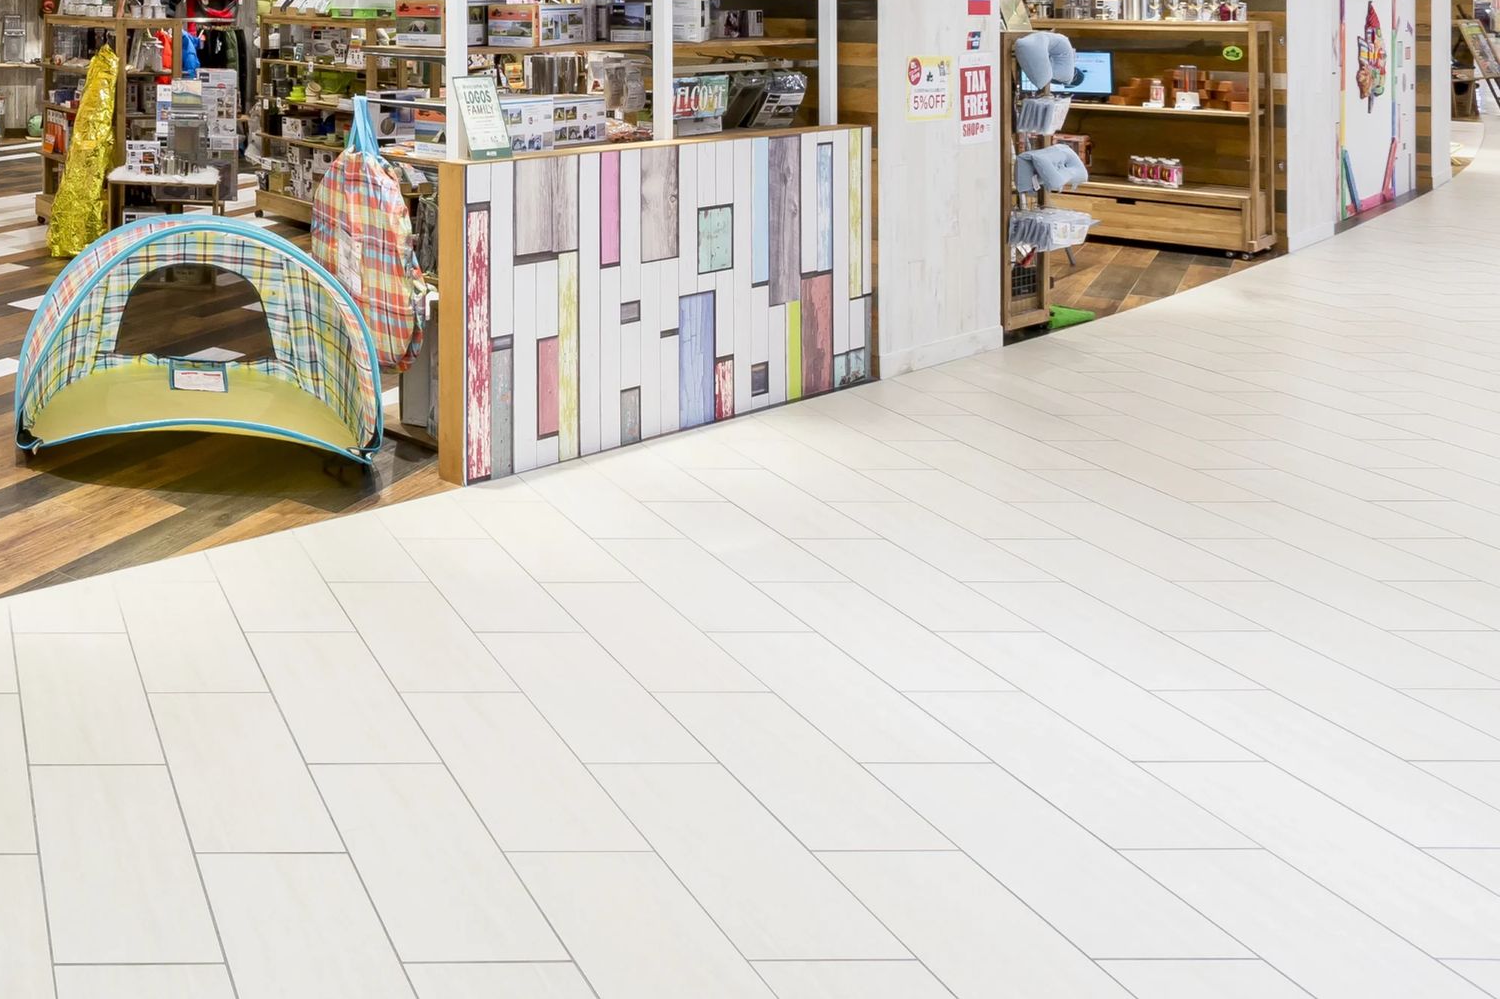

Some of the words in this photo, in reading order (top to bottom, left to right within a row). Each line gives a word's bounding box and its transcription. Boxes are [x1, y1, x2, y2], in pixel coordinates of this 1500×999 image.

[964, 70, 987, 93] TAX
[463, 90, 492, 104] LOGOS
[673, 84, 726, 113] ELCOME
[913, 95, 946, 111] 5%OFF
[466, 104, 494, 116] FAMILY
[963, 93, 988, 118] FREE
[962, 122, 980, 137] SHOP
